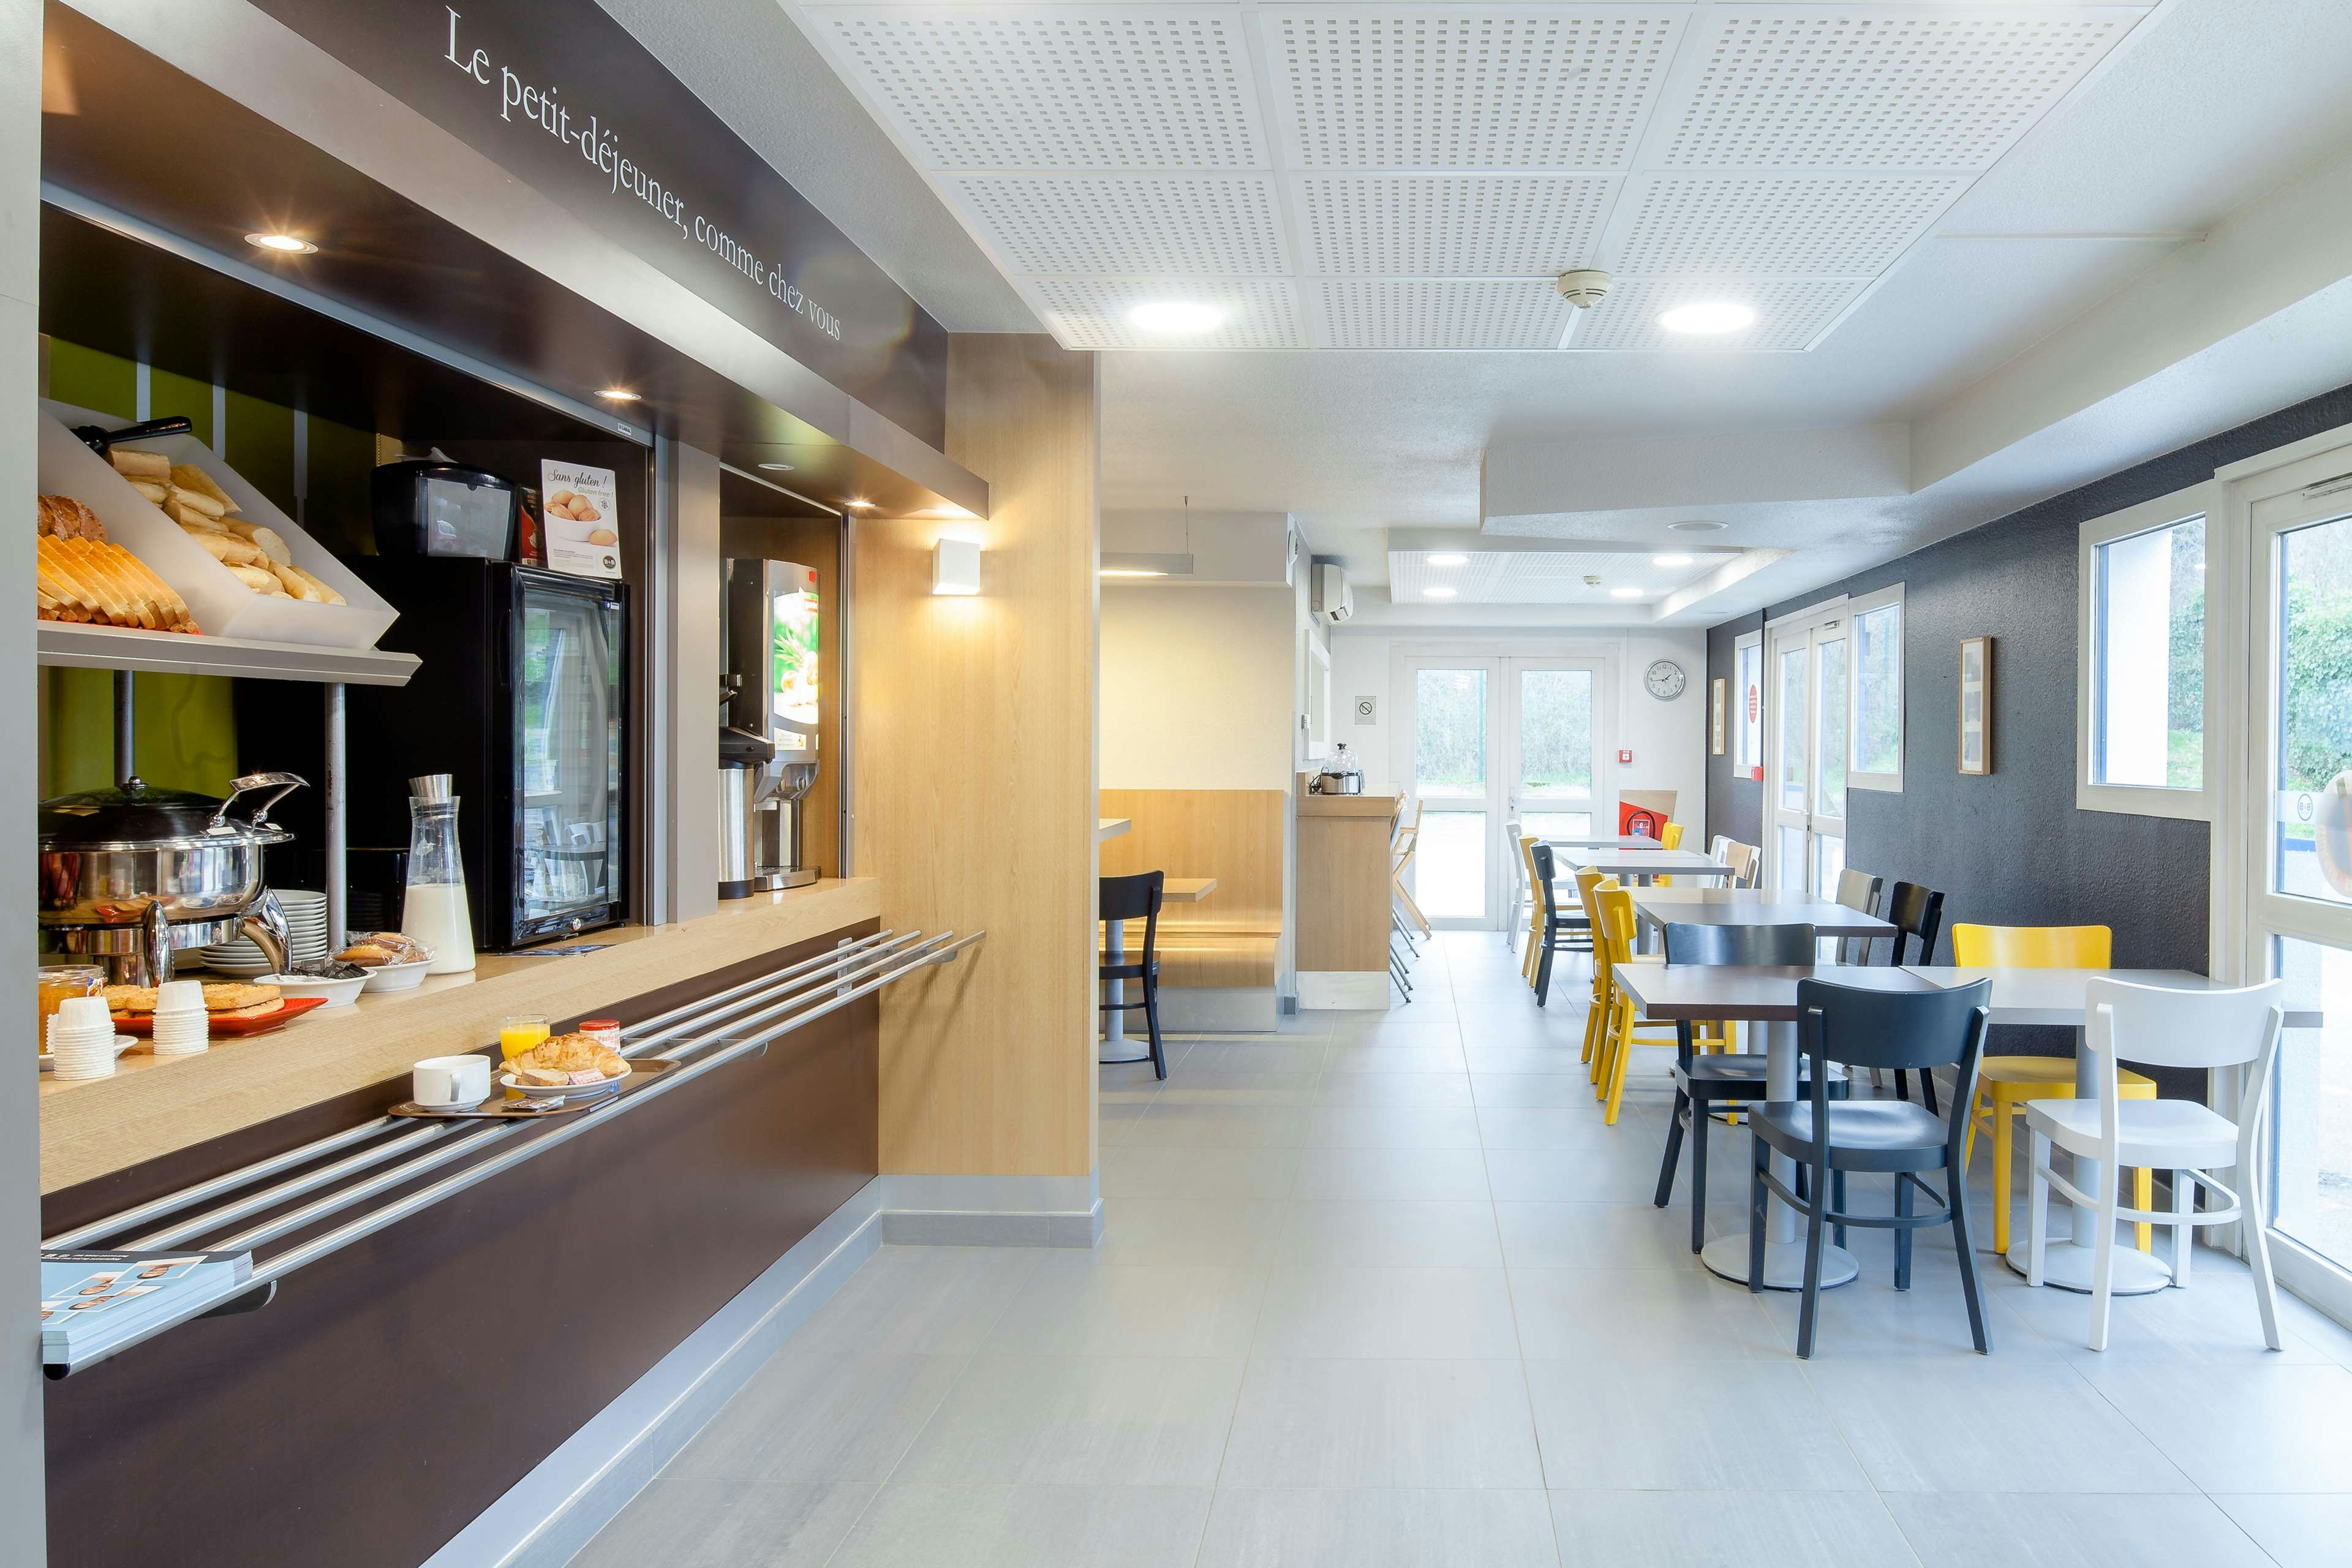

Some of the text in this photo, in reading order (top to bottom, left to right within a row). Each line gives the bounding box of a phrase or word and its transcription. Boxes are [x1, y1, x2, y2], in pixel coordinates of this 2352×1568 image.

[445, 5, 841, 341] Le petit-déjeuner, comme chez vous
[548, 469, 607, 489] Sans gluten !
[578, 486, 597, 495] Gluten
